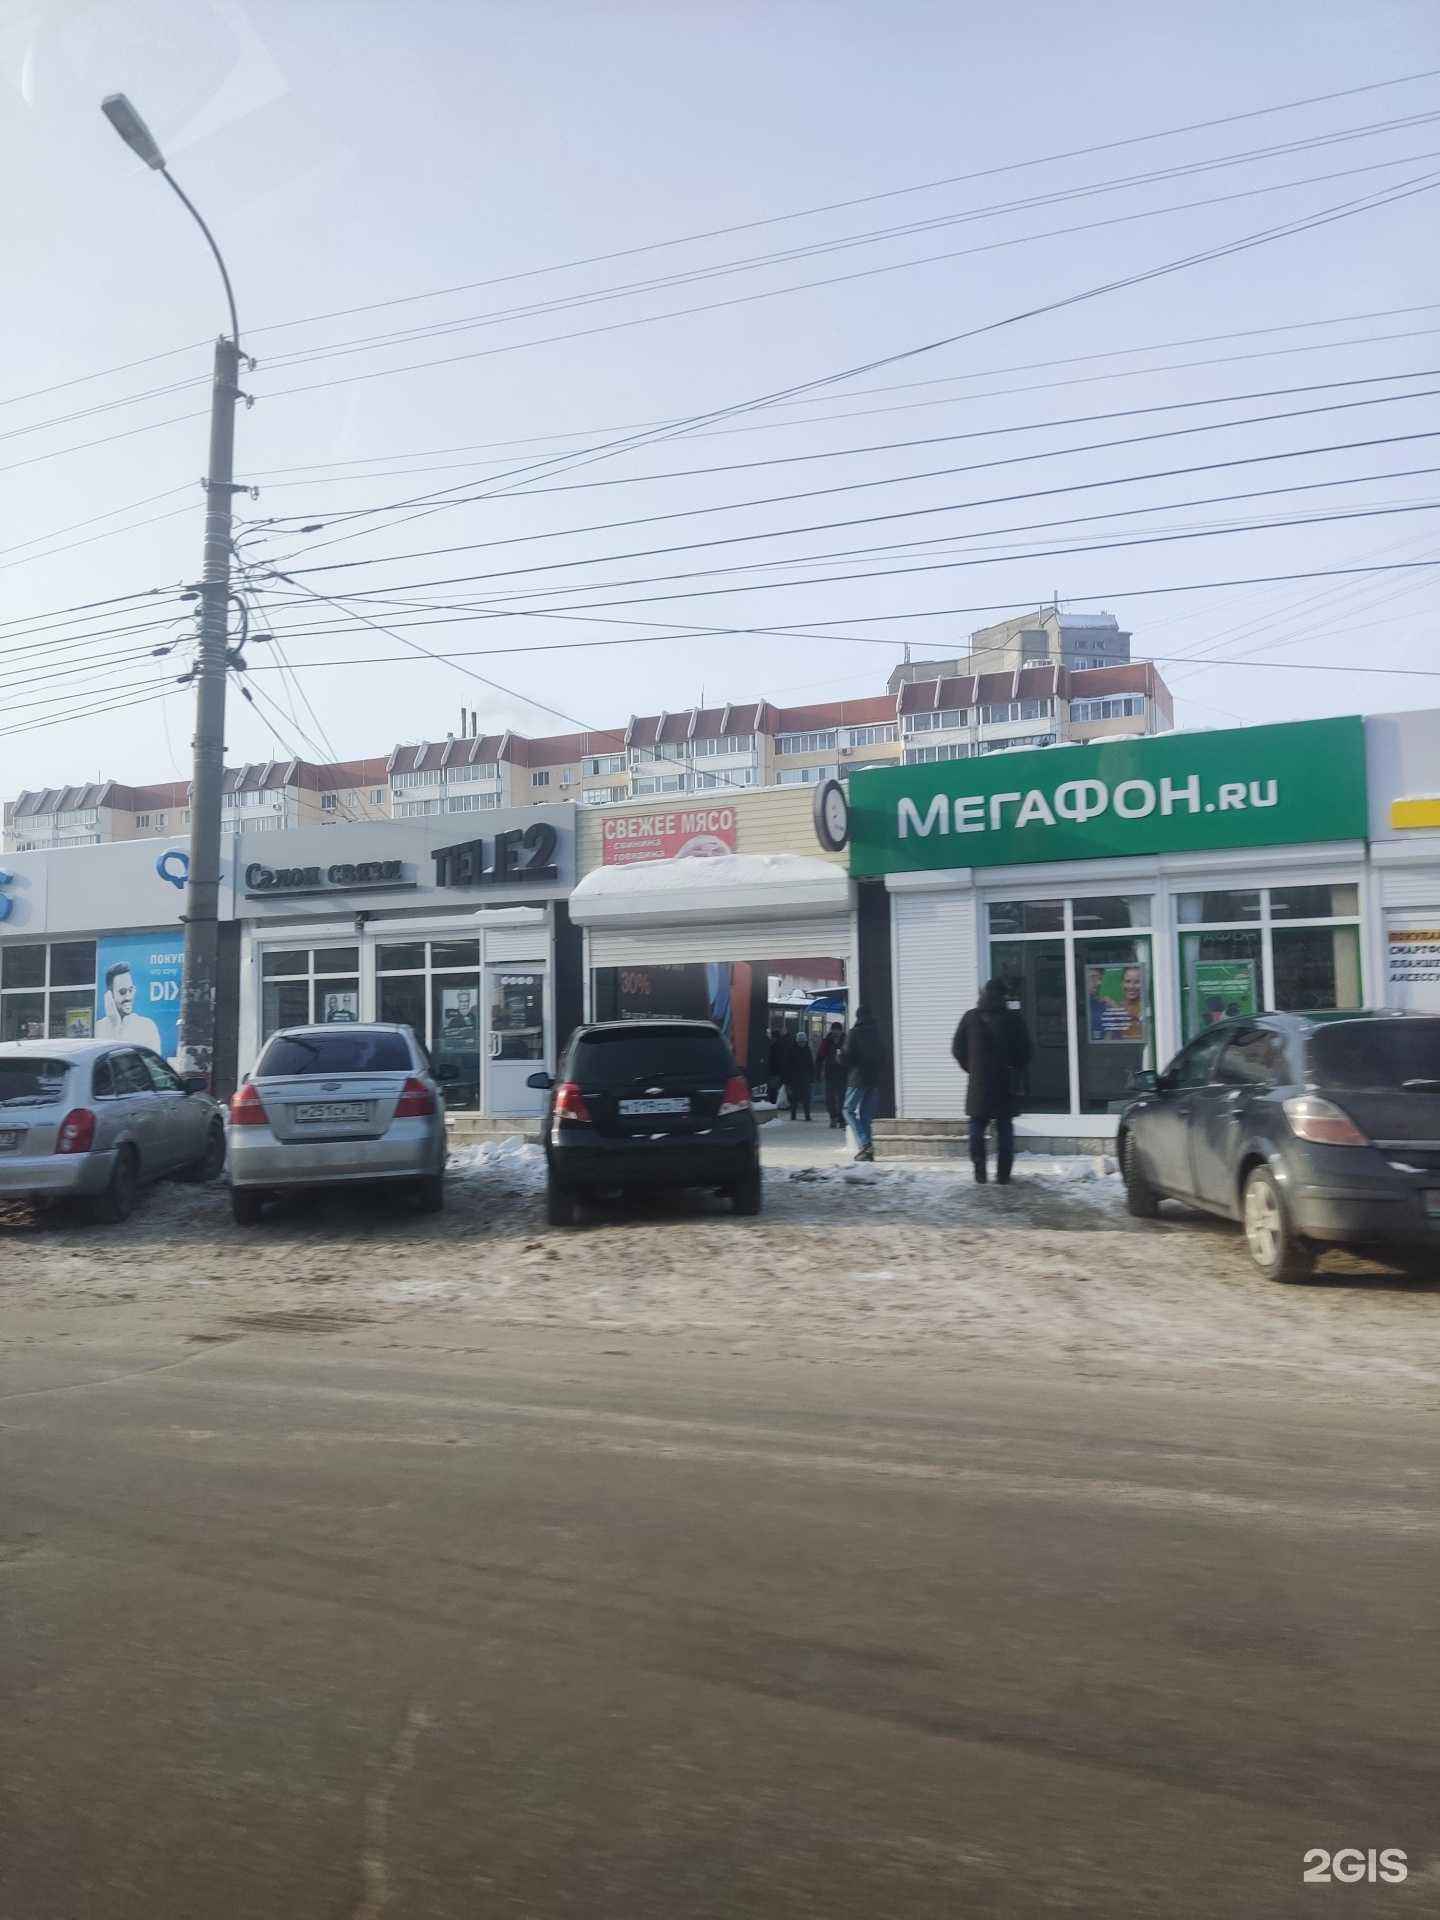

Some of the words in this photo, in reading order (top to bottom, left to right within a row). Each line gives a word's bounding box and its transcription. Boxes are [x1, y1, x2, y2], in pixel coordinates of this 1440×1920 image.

[604, 815, 676, 840] СВЕЖЕЕ
[681, 810, 733, 834] МЯСО
[431, 823, 558, 887] TELE2
[245, 863, 320, 890] Салон
[327, 860, 402, 884] связи
